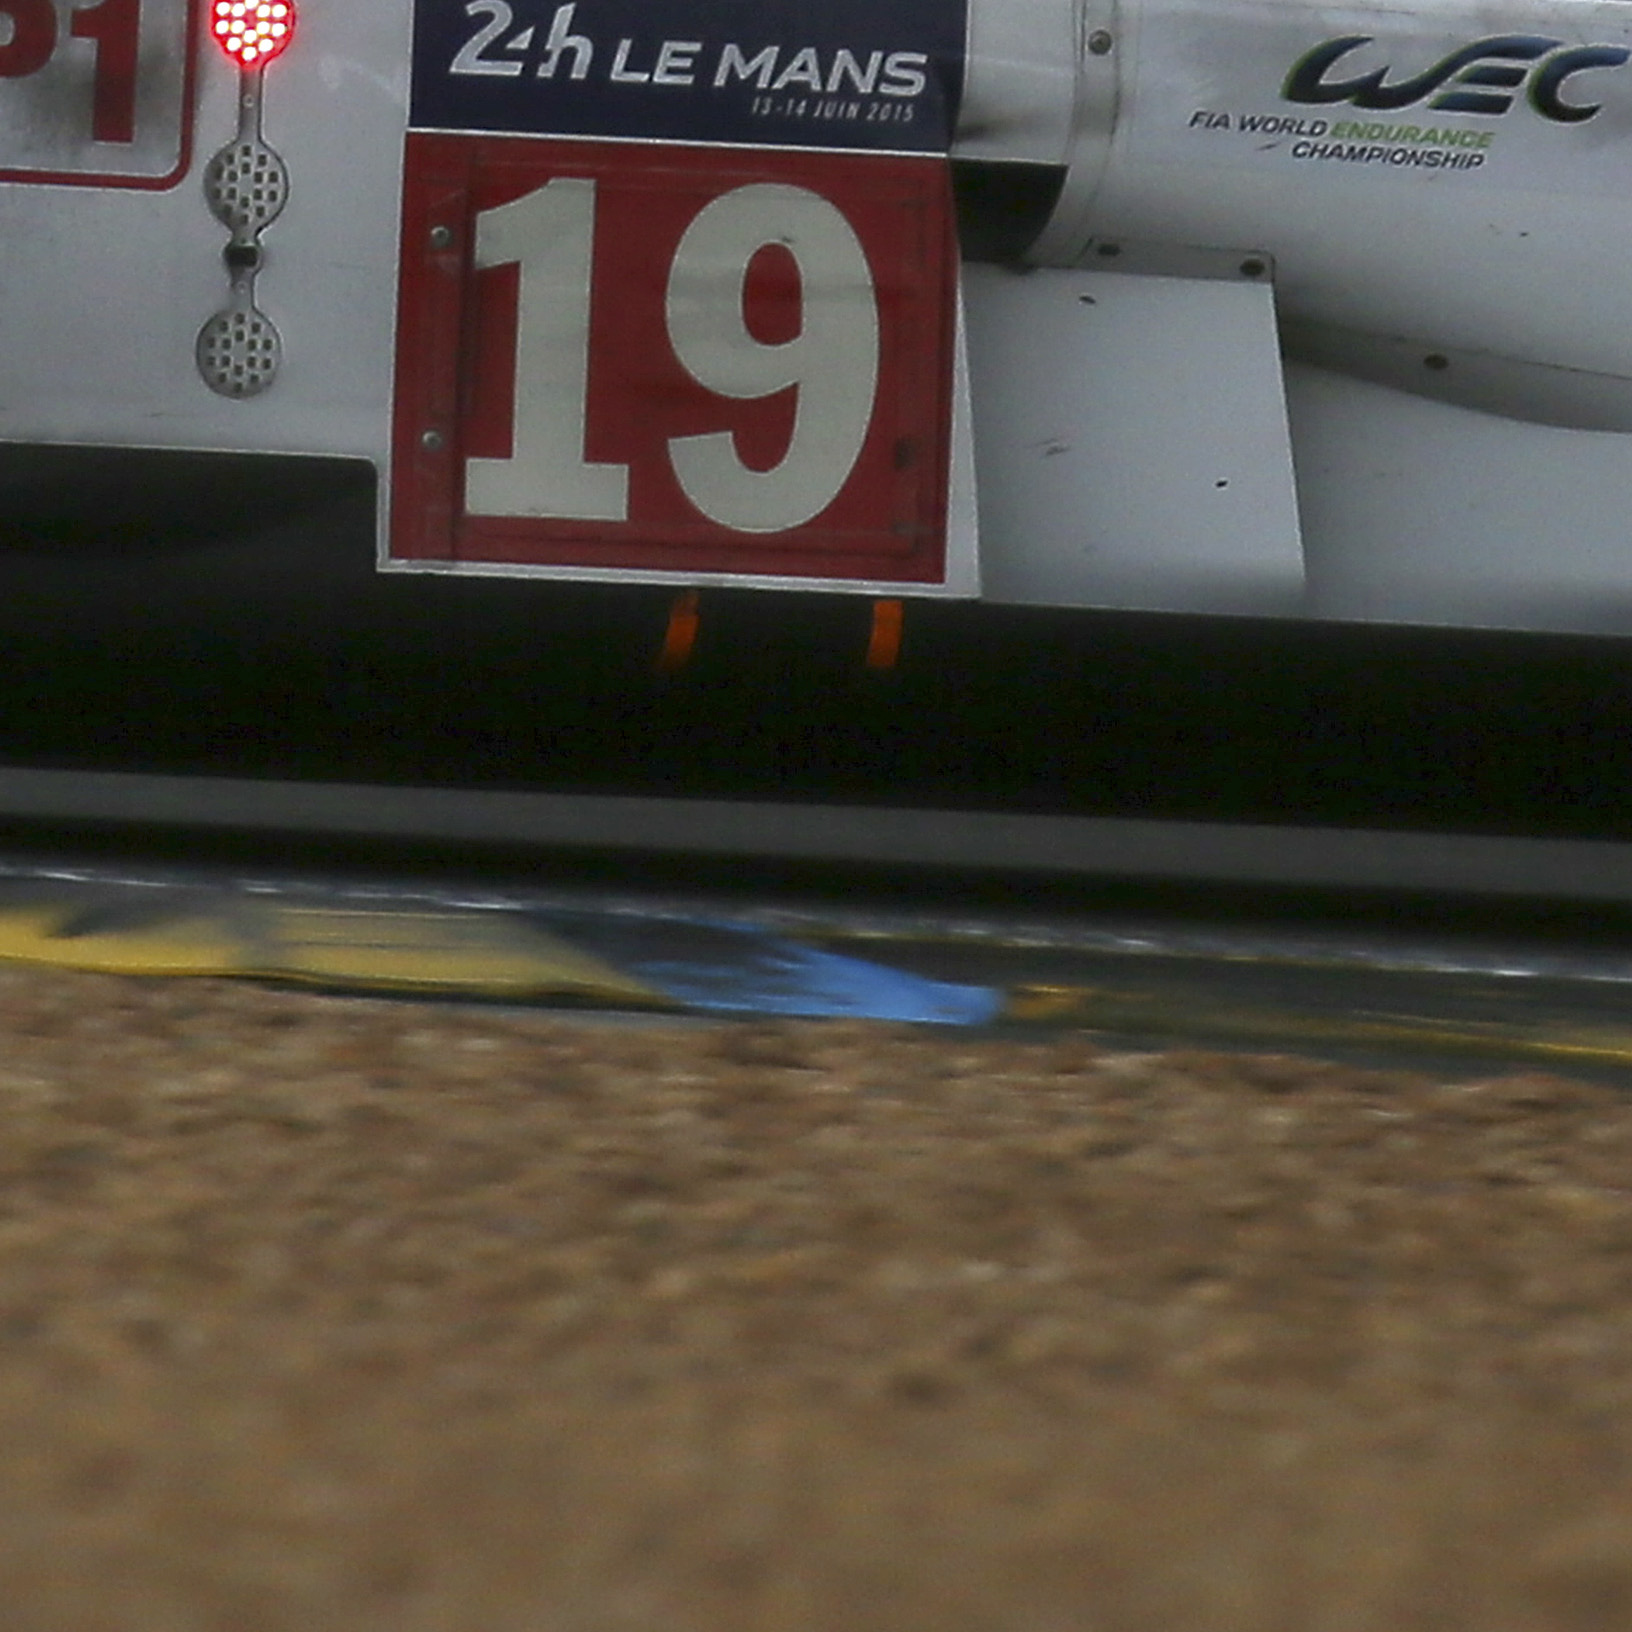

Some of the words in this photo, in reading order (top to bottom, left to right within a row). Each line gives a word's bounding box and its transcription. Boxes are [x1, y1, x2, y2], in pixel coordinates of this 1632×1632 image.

[609, 41, 702, 86] LE
[713, 45, 929, 97] MANS
[1279, 33, 1632, 124] WEC
[814, 99, 861, 119] JUIN
[866, 102, 915, 123] 2015
[1188, 110, 1232, 131] FIA
[1237, 113, 1328, 139] WORLD
[1330, 121, 1497, 149] ENDURANCE
[1291, 140, 1486, 171] CHAMPIONSHIP
[464, 176, 879, 533] 19
